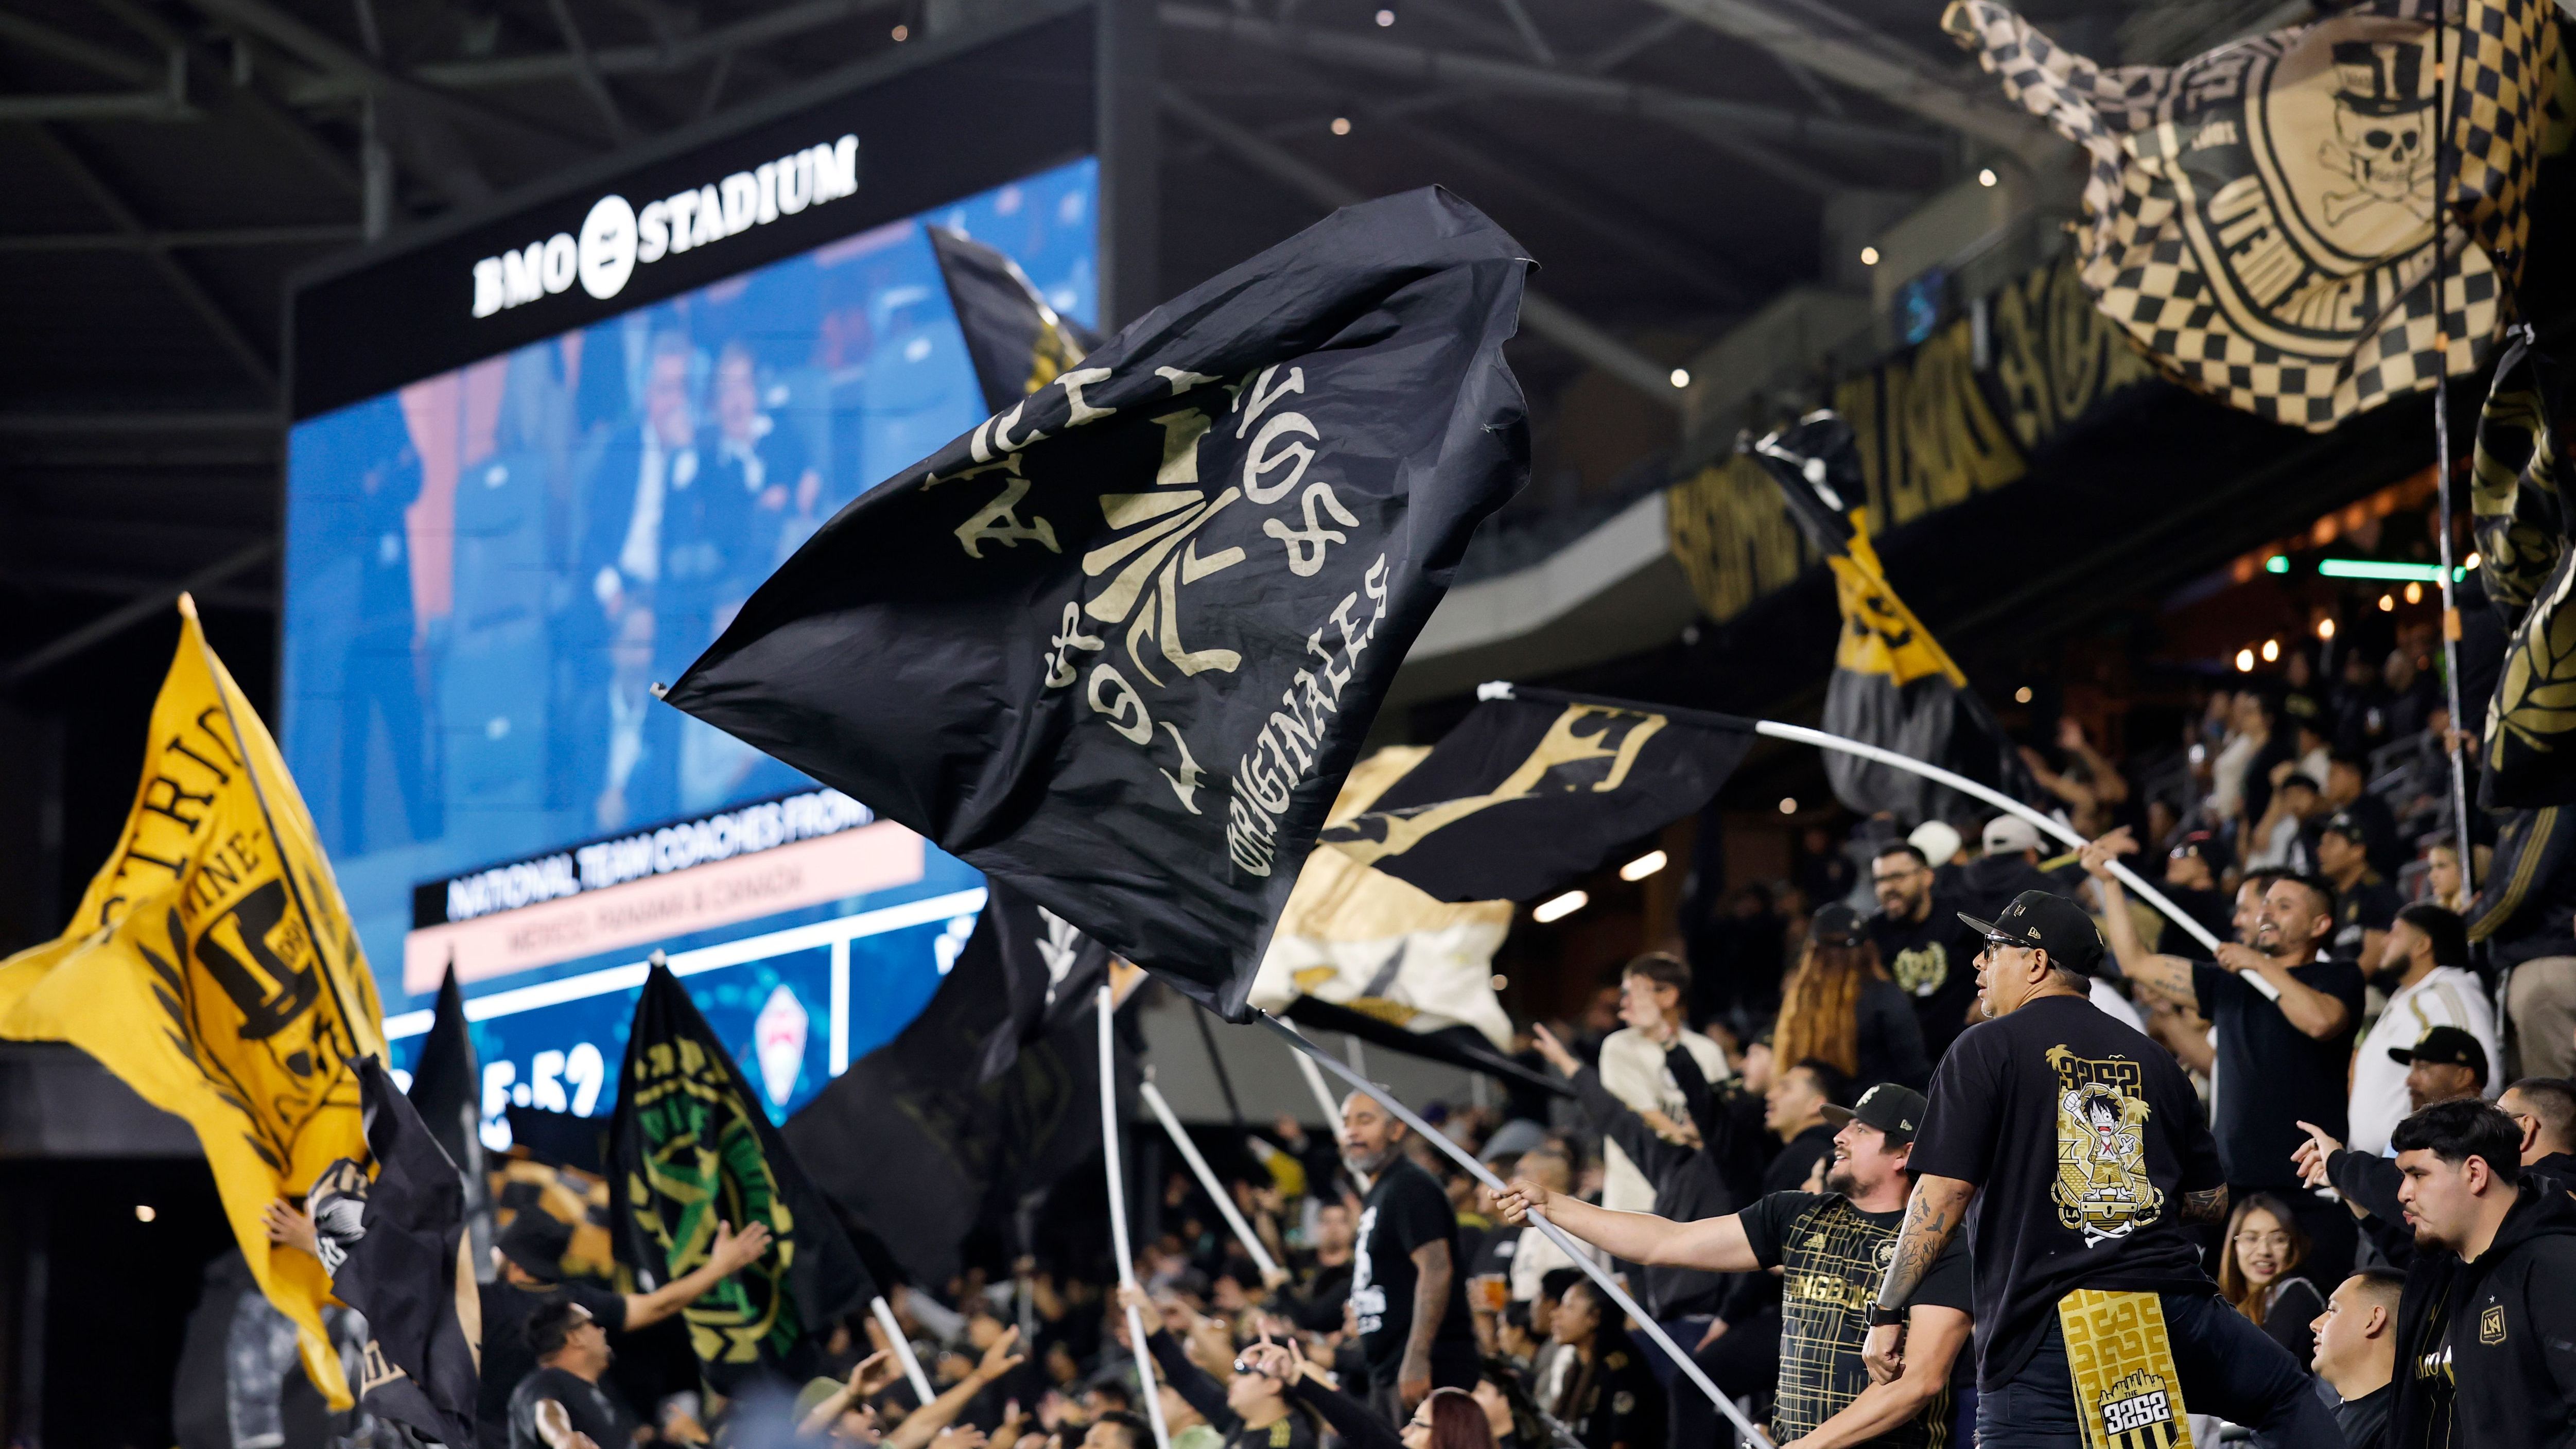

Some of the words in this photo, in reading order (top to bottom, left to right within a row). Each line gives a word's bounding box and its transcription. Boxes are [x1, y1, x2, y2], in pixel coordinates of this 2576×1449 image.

[472, 232, 578, 319] BMO
[637, 133, 860, 264] STADIUM
[1226, 552, 1389, 877] ORIGINALES
[447, 852, 581, 922] NATIONAL
[576, 832, 654, 890] TEAM
[653, 801, 785, 874] COACHES
[2065, 1209, 2080, 1218] LA
[2103, 1391, 2170, 1435] 3252
